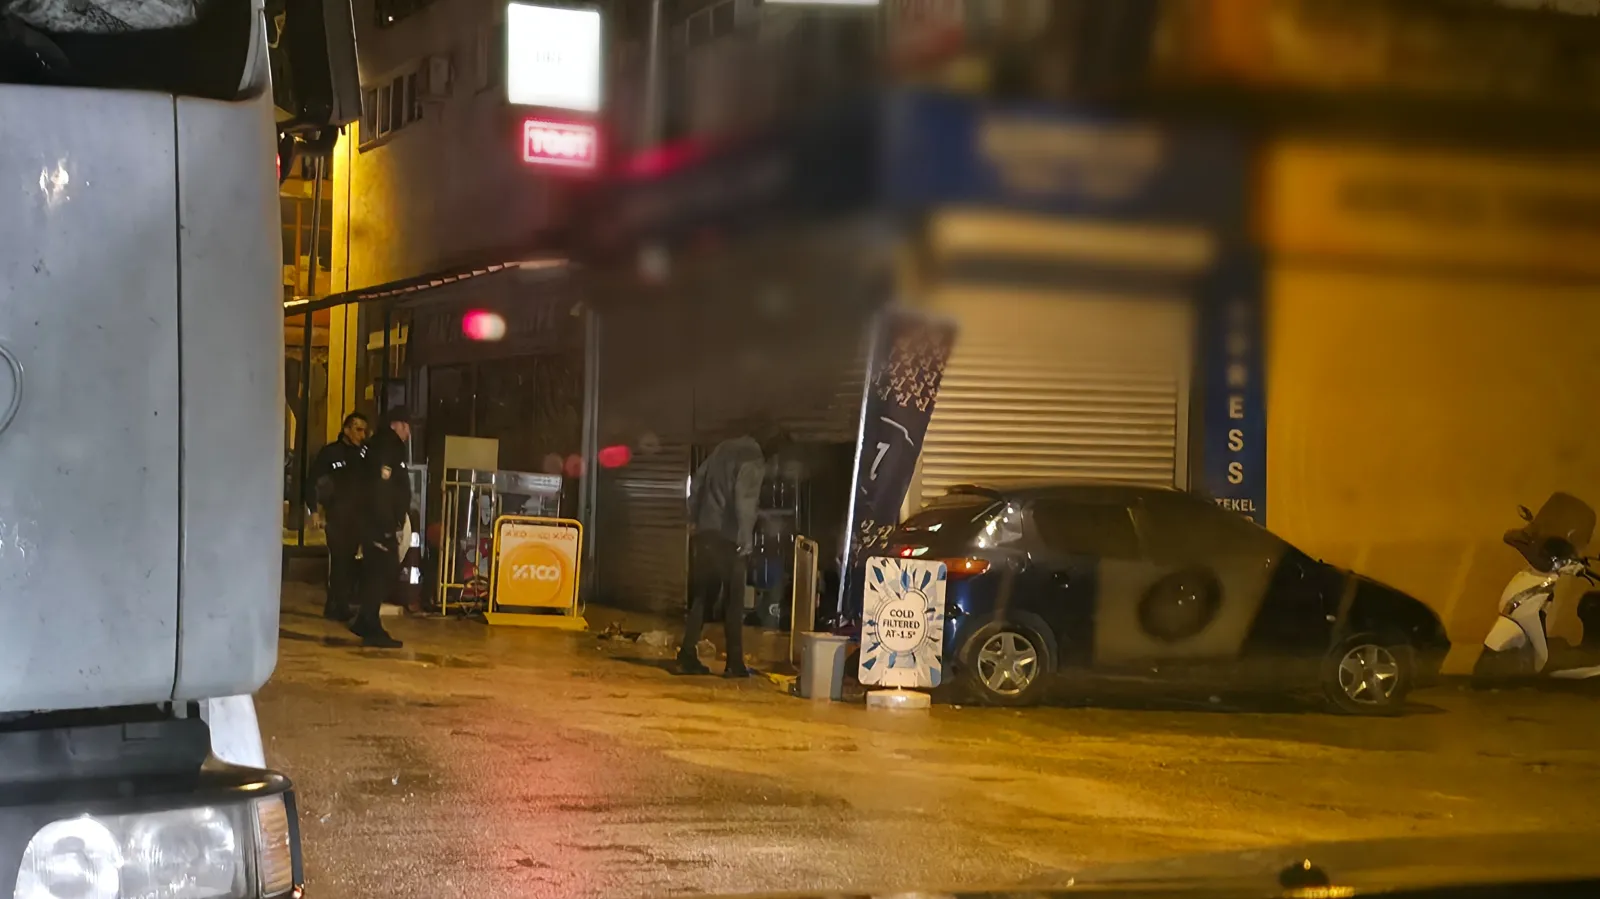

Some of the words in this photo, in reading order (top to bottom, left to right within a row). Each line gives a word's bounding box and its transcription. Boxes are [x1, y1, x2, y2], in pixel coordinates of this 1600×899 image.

[1214, 498, 1256, 512] TEKEL
[889, 608, 914, 618] COLD
[882, 618, 920, 629] FILTERED
[885, 629, 896, 638] AT
